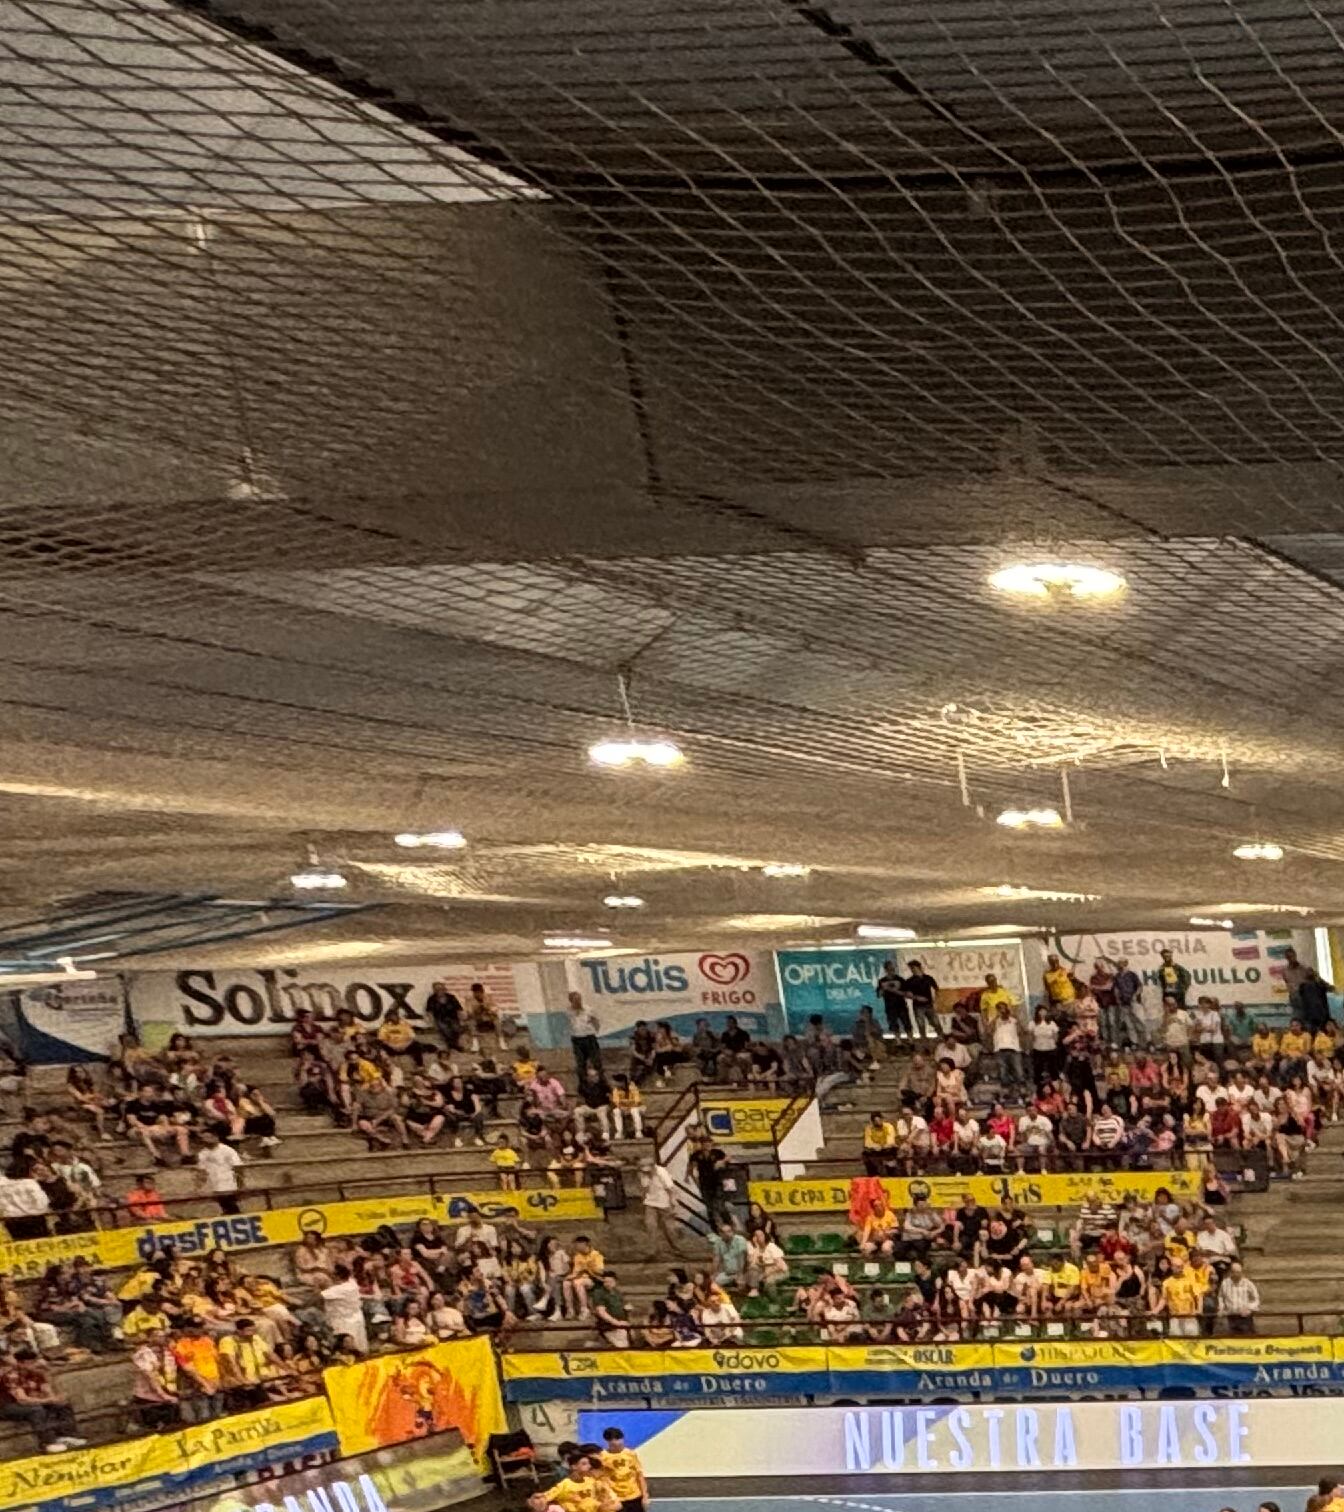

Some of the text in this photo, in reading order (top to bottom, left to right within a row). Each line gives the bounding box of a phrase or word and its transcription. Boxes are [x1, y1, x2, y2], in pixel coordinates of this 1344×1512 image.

[581, 958, 689, 996] Tudis
[176, 967, 425, 1027] Solinox
[701, 989, 757, 1006] FRIGO
[917, 1371, 993, 1392] Aranda
[1030, 1367, 1099, 1387] Duero
[1253, 1362, 1330, 1384] Aranda
[591, 1376, 664, 1398] Aranda
[700, 1374, 768, 1394] Duero
[844, 1403, 1253, 1471] NUESTRA BASE
